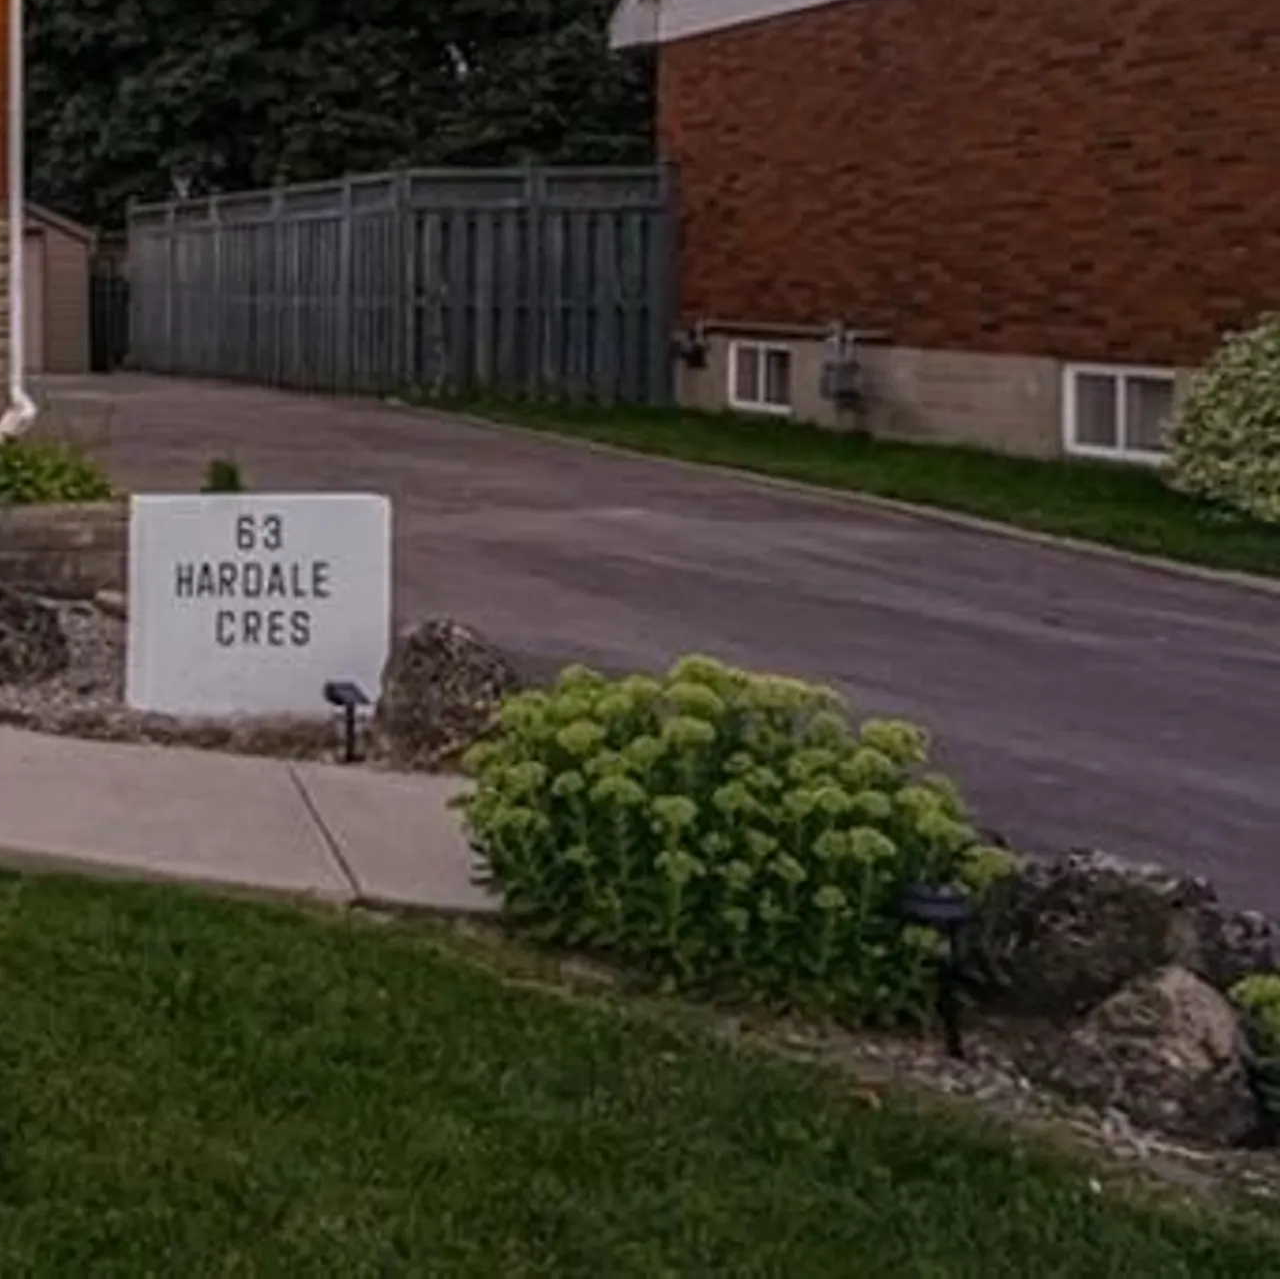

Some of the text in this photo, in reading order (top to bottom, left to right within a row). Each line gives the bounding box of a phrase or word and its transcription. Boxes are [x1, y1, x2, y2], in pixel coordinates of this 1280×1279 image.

[237, 515, 283, 551] 63
[175, 561, 332, 598] HARDALE
[215, 610, 311, 646] CRES
